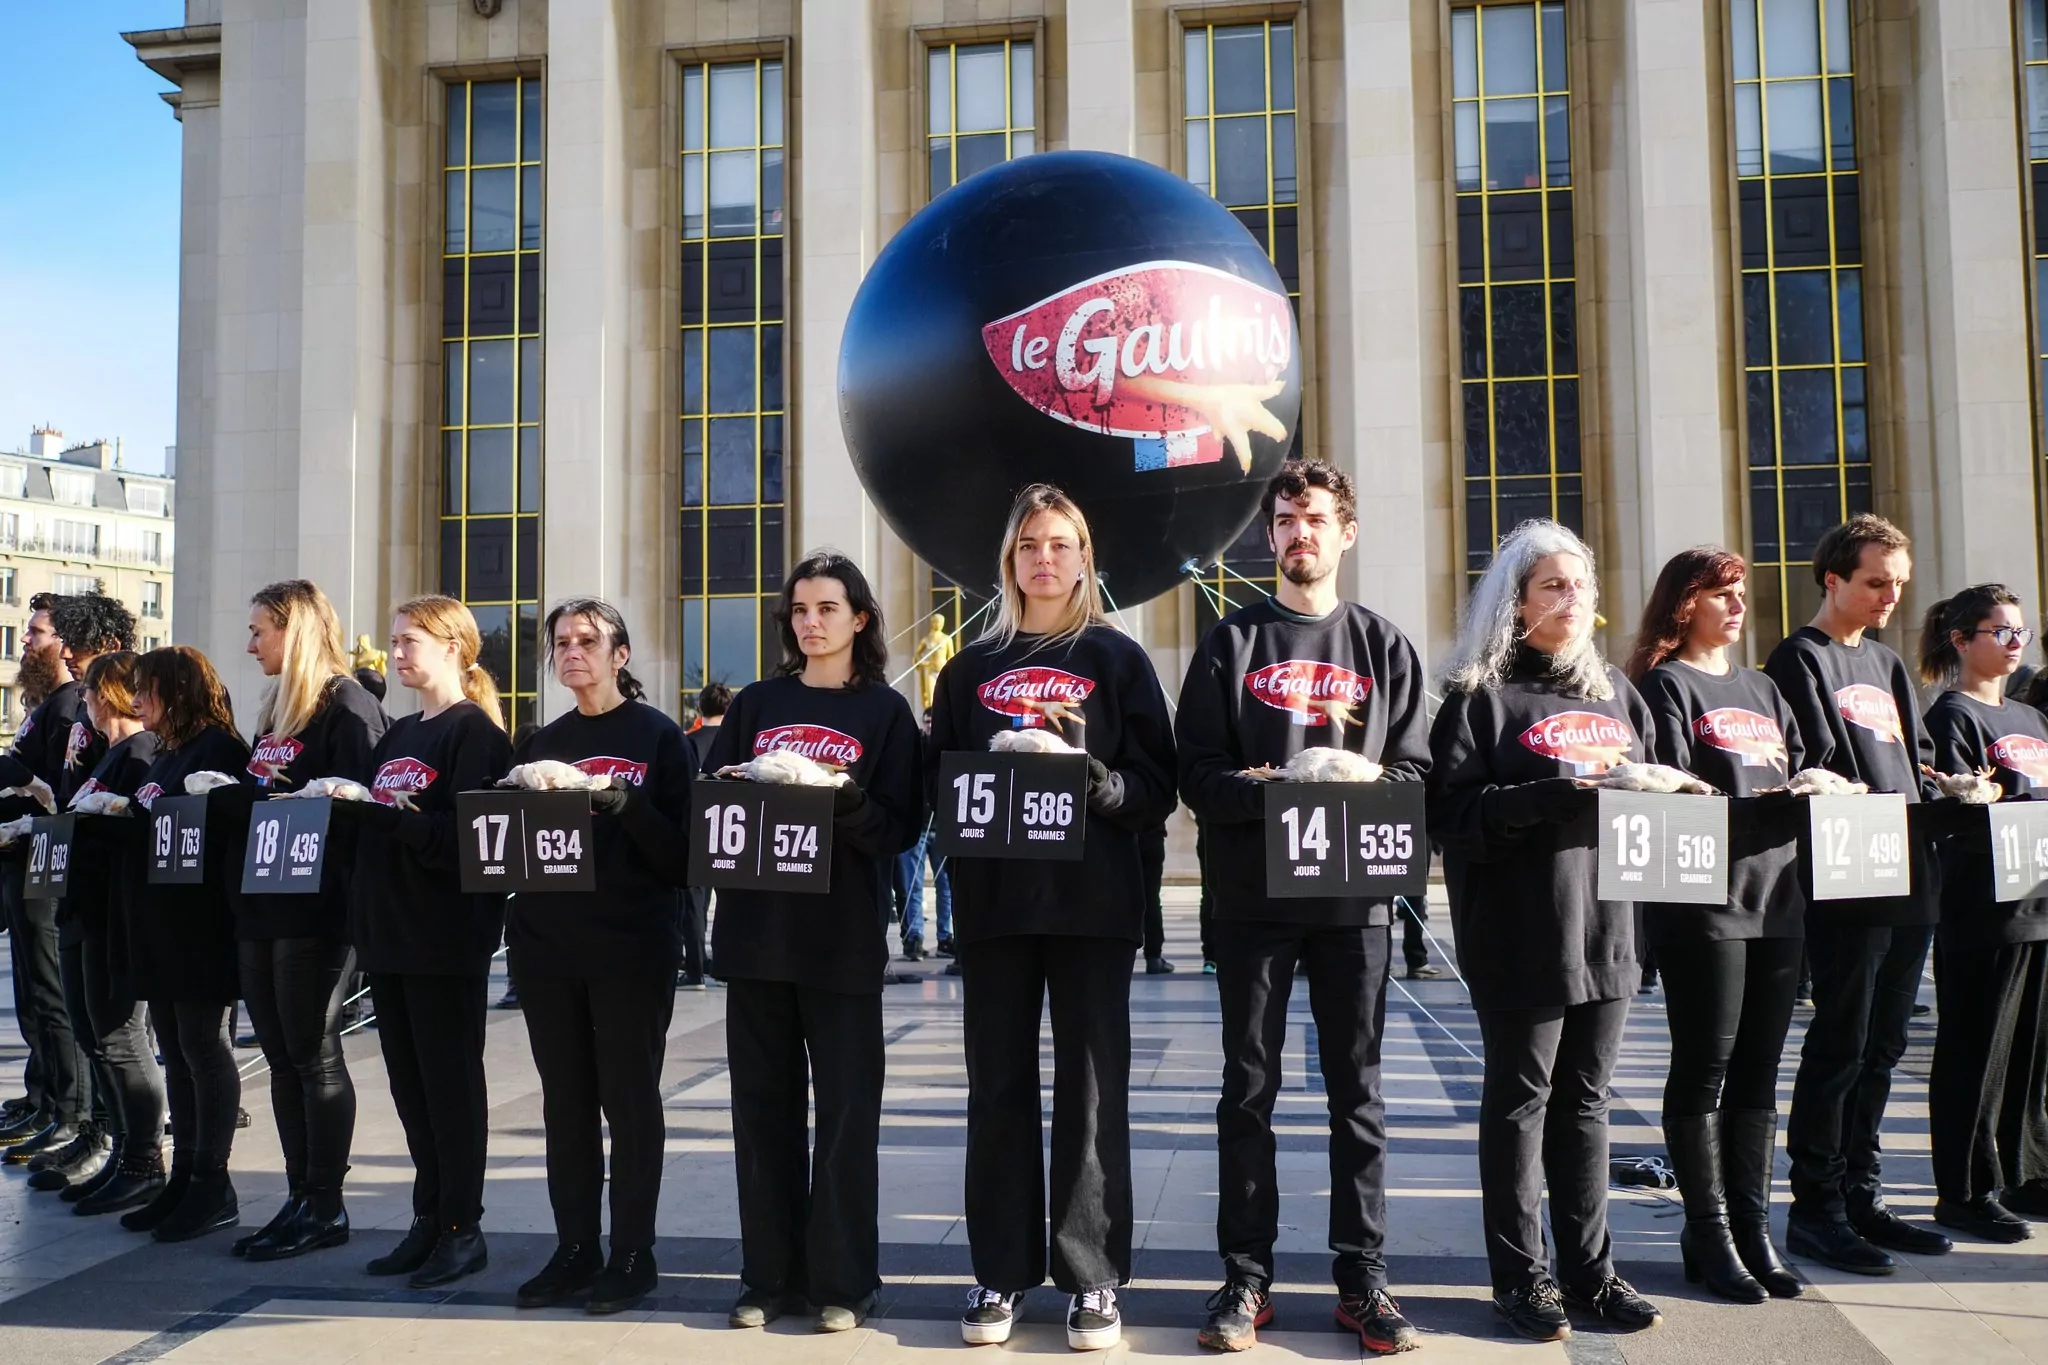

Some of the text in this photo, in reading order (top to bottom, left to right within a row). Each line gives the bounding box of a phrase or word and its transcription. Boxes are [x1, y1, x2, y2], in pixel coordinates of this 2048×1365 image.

[1012, 294, 1288, 407] le Gaulois
[983, 674, 1087, 702] le Gaulois
[1253, 667, 1367, 700] le Gaulois
[1528, 720, 1633, 748] le Gaulois
[1699, 721, 1712, 737] le
[756, 730, 858, 762] le Gaulois
[953, 773, 996, 824] 15
[1022, 792, 1073, 826] 586
[155, 815, 172, 857] 19
[181, 827, 200, 855] 763
[255, 819, 280, 865] 18
[472, 814, 510, 861] 17
[536, 829, 583, 861] 634
[704, 804, 746, 856] 16
[773, 824, 818, 859] 574
[960, 828, 985, 839] JOURS
[1027, 830, 1066, 841] GRAMMES
[1281, 806, 1330, 861] 14
[1359, 824, 1413, 860] 535
[1612, 814, 1651, 867] 13
[1820, 818, 1851, 866] 12
[29, 832, 48, 873] 20
[51, 844, 68, 871] 603
[290, 832, 320, 863] 436
[1677, 834, 1716, 870] 518
[1869, 832, 1901, 864] 498
[2001, 824, 2021, 870] 11
[483, 865, 505, 875] JOURS
[543, 864, 578, 874] GRAMMES
[712, 859, 736, 870] JOURS
[776, 862, 813, 873] GRAMMES
[1293, 865, 1321, 876] JOURS
[1366, 864, 1408, 876] GRAMMES
[1620, 871, 1643, 882] JOURS
[1680, 873, 1713, 884] GRAMMES
